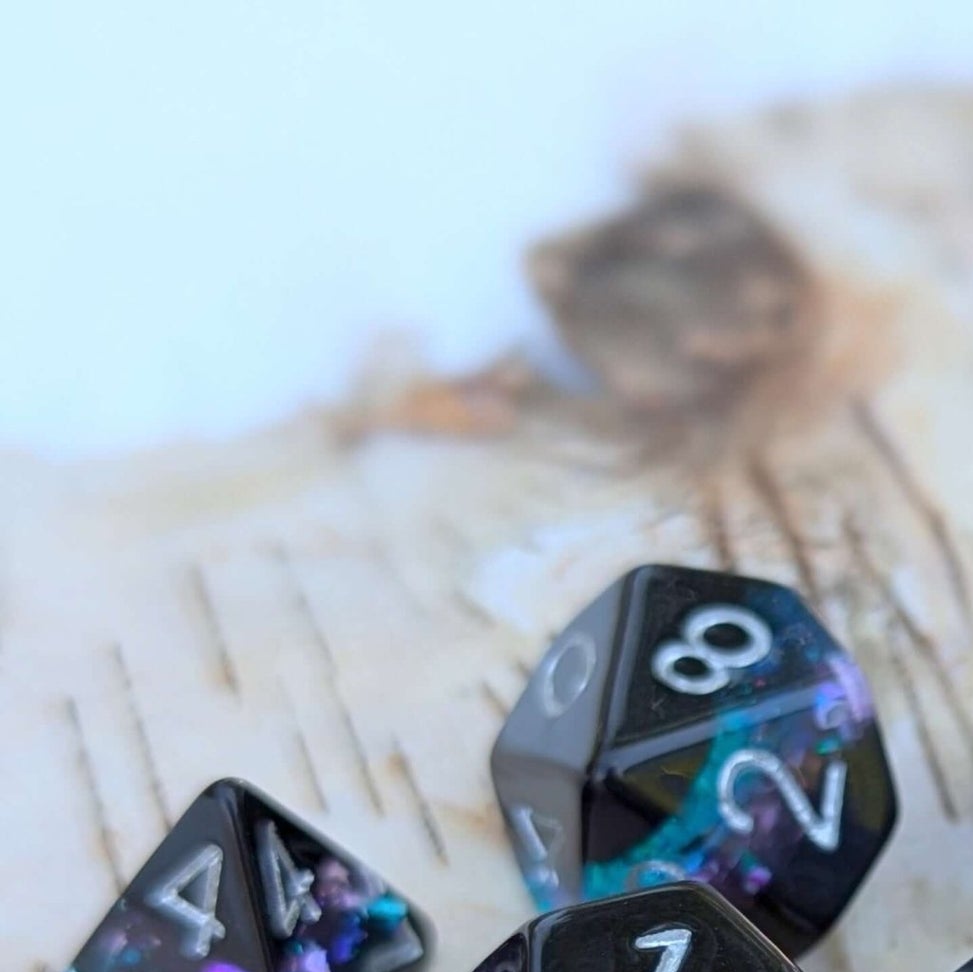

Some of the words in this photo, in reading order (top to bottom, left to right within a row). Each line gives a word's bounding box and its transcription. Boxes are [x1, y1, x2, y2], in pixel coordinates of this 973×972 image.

[650, 604, 774, 695] 8
[717, 749, 847, 851] 2
[146, 843, 225, 958] 4
[255, 819, 321, 939] 4
